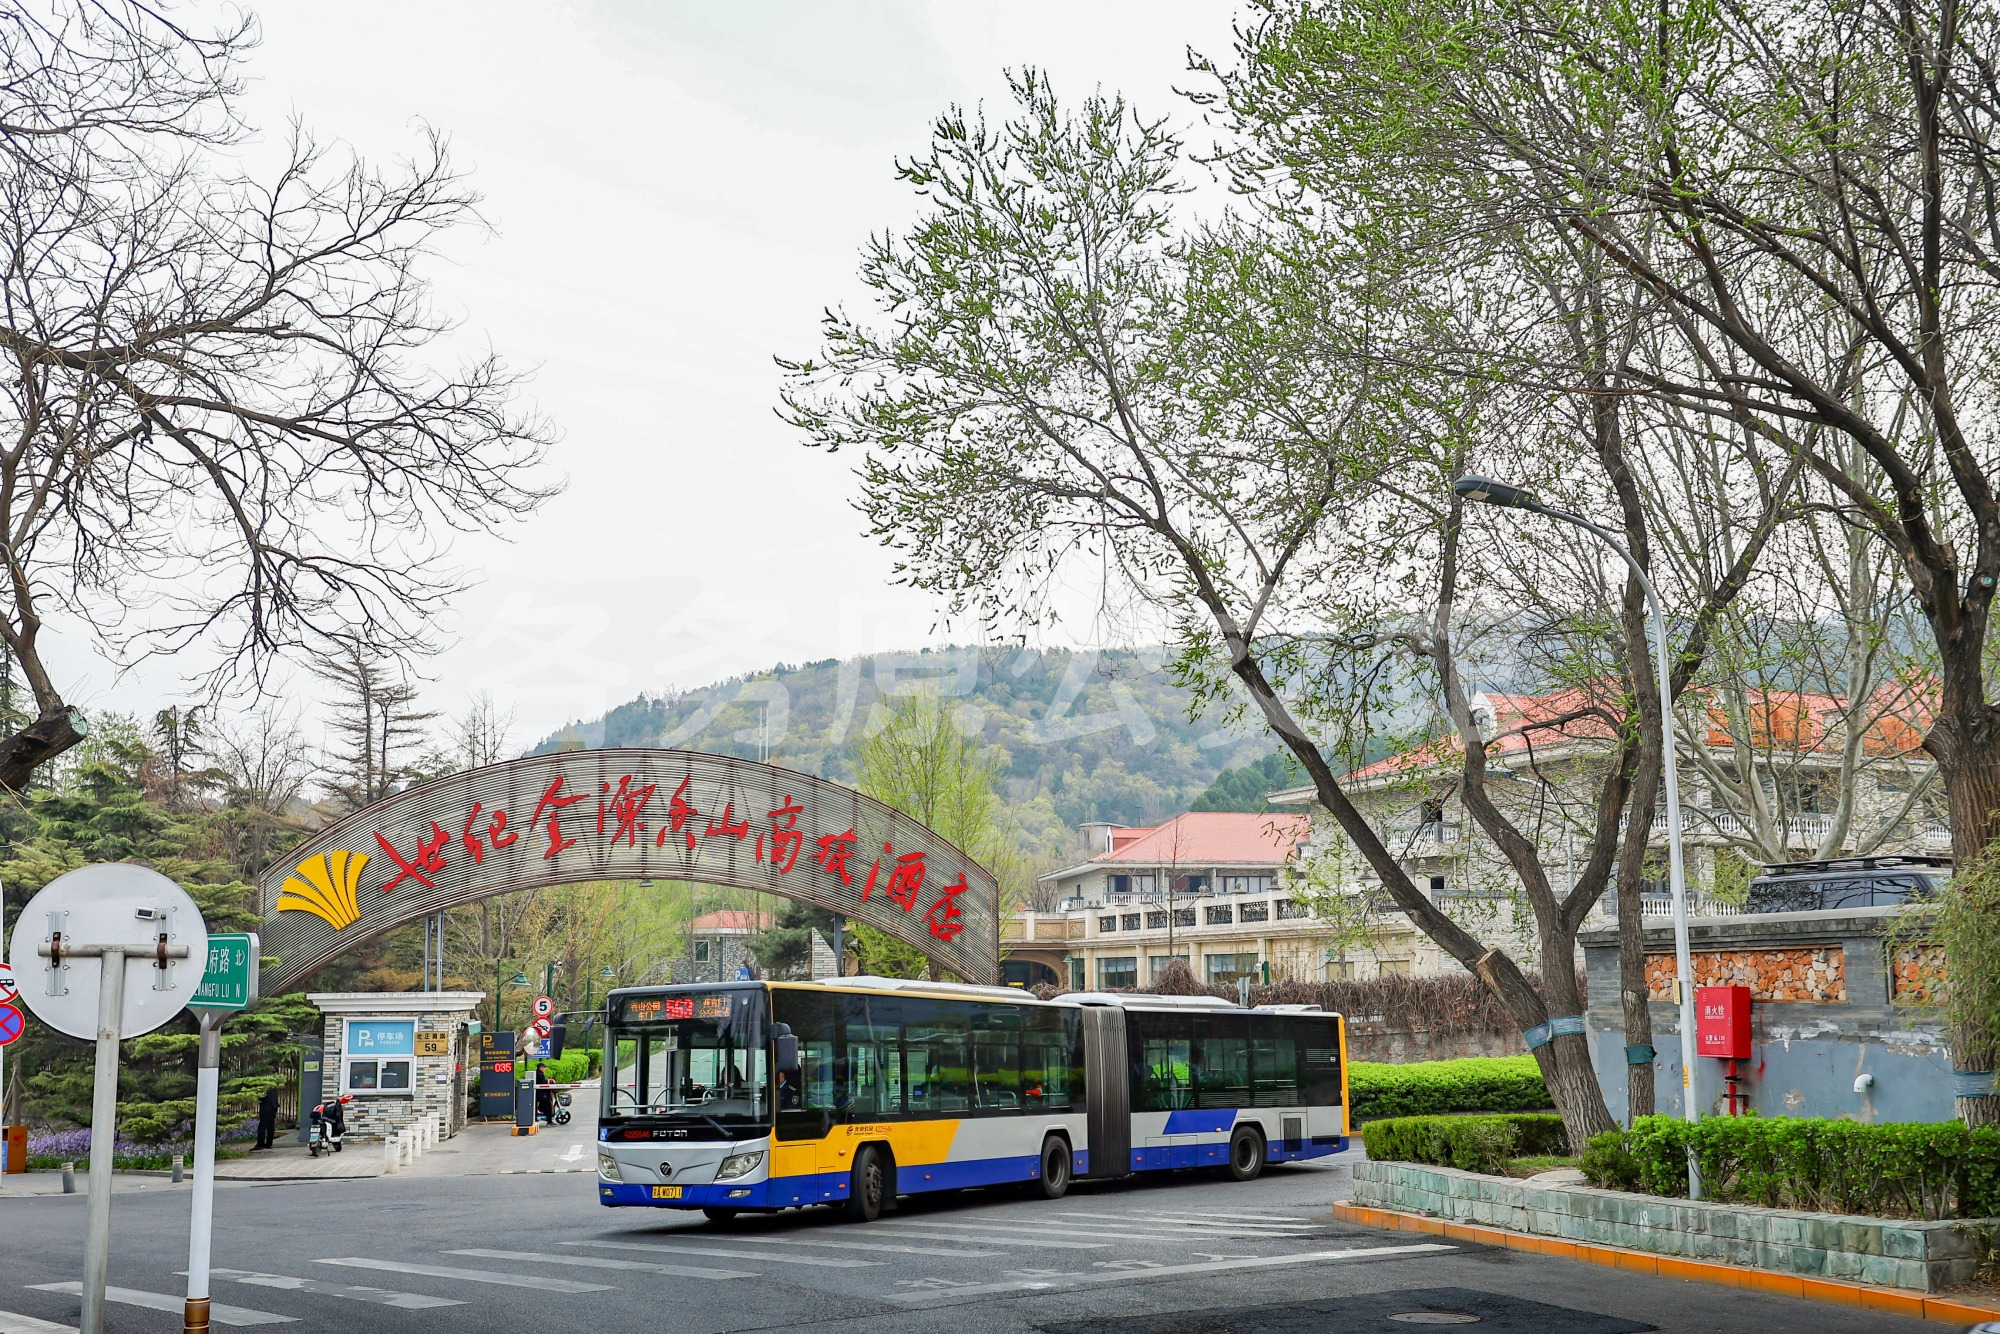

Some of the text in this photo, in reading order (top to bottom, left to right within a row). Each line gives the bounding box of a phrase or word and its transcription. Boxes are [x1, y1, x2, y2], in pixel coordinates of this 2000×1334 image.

[205, 946, 242, 975] 府路 北
[195, 983, 241, 998] WANGFU LU N
[539, 1000, 548, 1012] 5
[1704, 1005, 1725, 1015] 消火栓
[358, 1029, 371, 1047] P
[377, 1031, 404, 1041] 停车场
[482, 1035, 493, 1047] P
[424, 1043, 437, 1052] 59
[494, 1062, 512, 1073] 035
